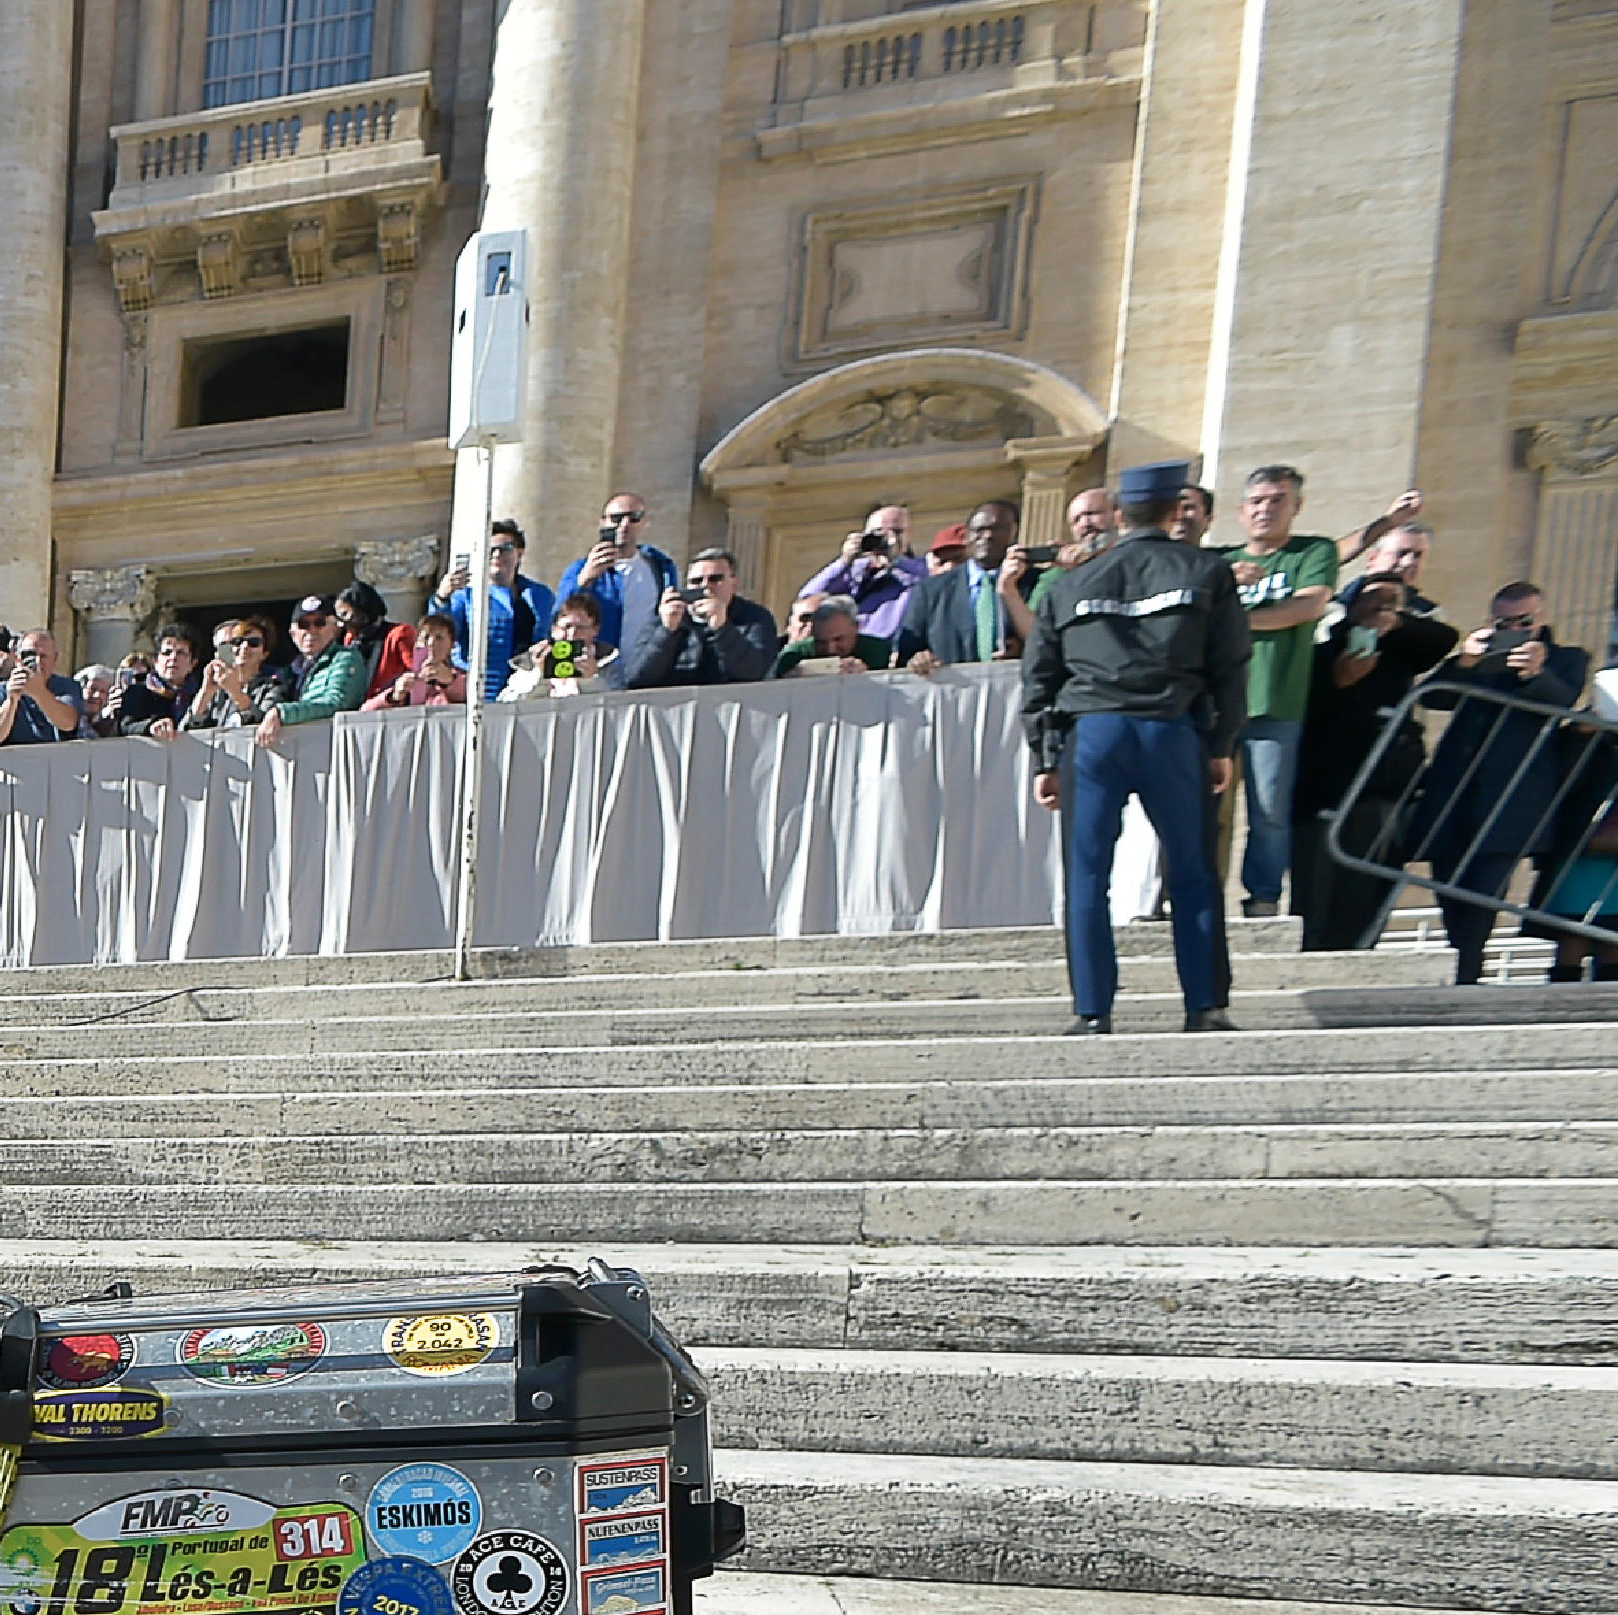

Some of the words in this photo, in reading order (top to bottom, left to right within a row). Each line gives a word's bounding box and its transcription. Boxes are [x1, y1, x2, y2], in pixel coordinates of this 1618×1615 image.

[429, 1322, 452, 1332] 90
[72, 1402, 158, 1423] THORENS
[586, 1468, 658, 1487] SUSTENPASS
[376, 1498, 472, 1530] ESKIMÓS
[171, 1540, 246, 1557] Portugal
[249, 1535, 270, 1550] de
[280, 1517, 346, 1558] 314
[469, 1535, 506, 1563] ACE
[508, 1535, 557, 1565] CAFE
